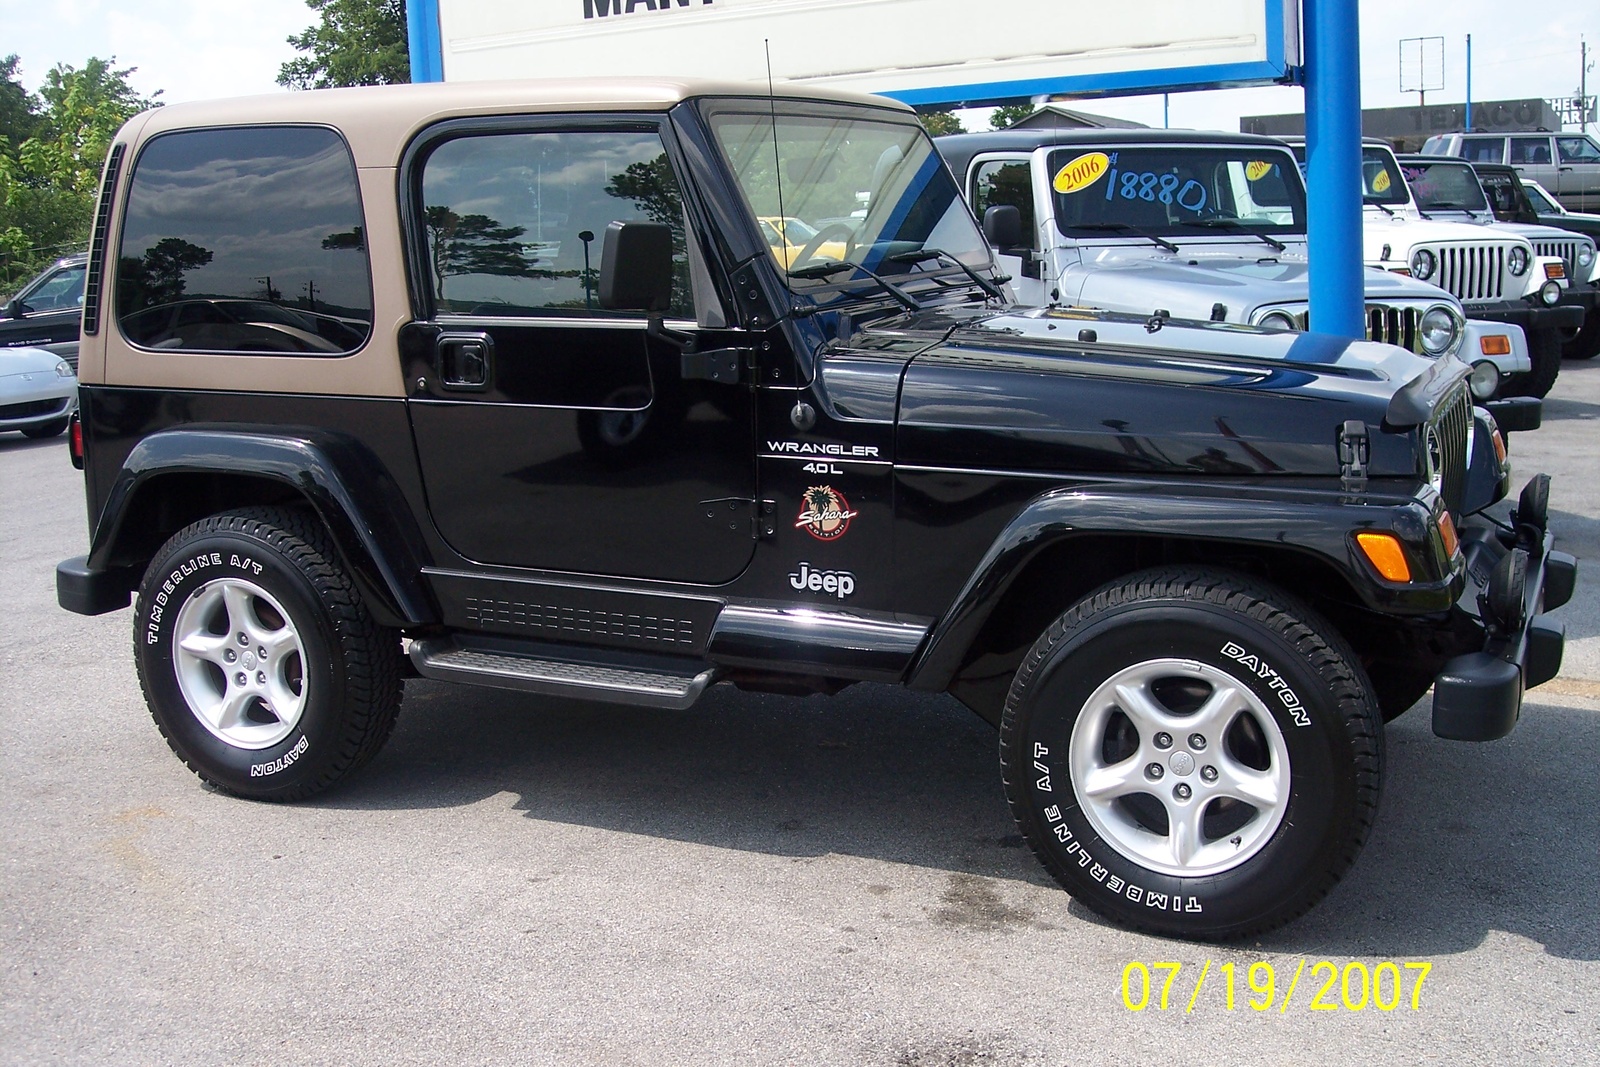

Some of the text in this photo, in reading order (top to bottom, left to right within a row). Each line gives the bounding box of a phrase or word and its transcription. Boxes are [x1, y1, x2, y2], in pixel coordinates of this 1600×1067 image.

[1544, 96, 1596, 112] HELY
[1555, 109, 1590, 124] ART
[1062, 156, 1100, 190] 2006
[1106, 168, 1207, 211] 18880
[1375, 173, 1389, 191] 200
[767, 441, 879, 457] WRANGLER
[795, 507, 857, 527] Sahara
[808, 524, 845, 537] EDITION
[789, 563, 856, 599] Jeep
[148, 552, 263, 645] TIMBERLINE A/T
[1220, 641, 1312, 728] DAYTON
[250, 734, 310, 778] DAYTON
[1034, 742, 1203, 914] TIMBERLINE A/T
